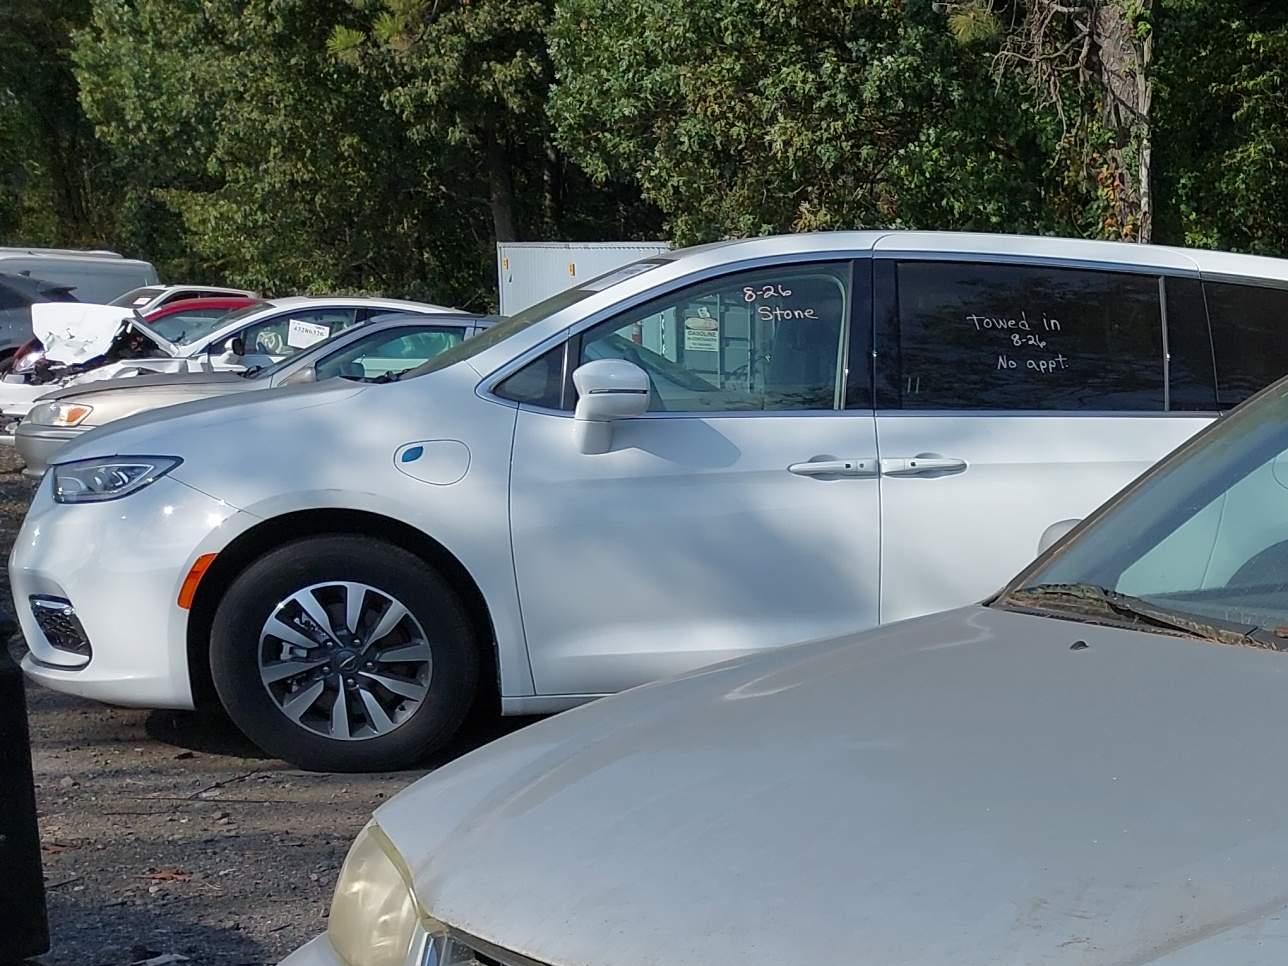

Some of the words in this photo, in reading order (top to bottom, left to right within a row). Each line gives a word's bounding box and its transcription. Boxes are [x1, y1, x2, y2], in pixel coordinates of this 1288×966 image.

[742, 283, 792, 303] 8-26
[757, 305, 819, 322] Stone
[965, 311, 1031, 331] Towed
[1042, 312, 1062, 331] in
[1010, 333, 1047, 349] 8-26
[997, 354, 1017, 371] No
